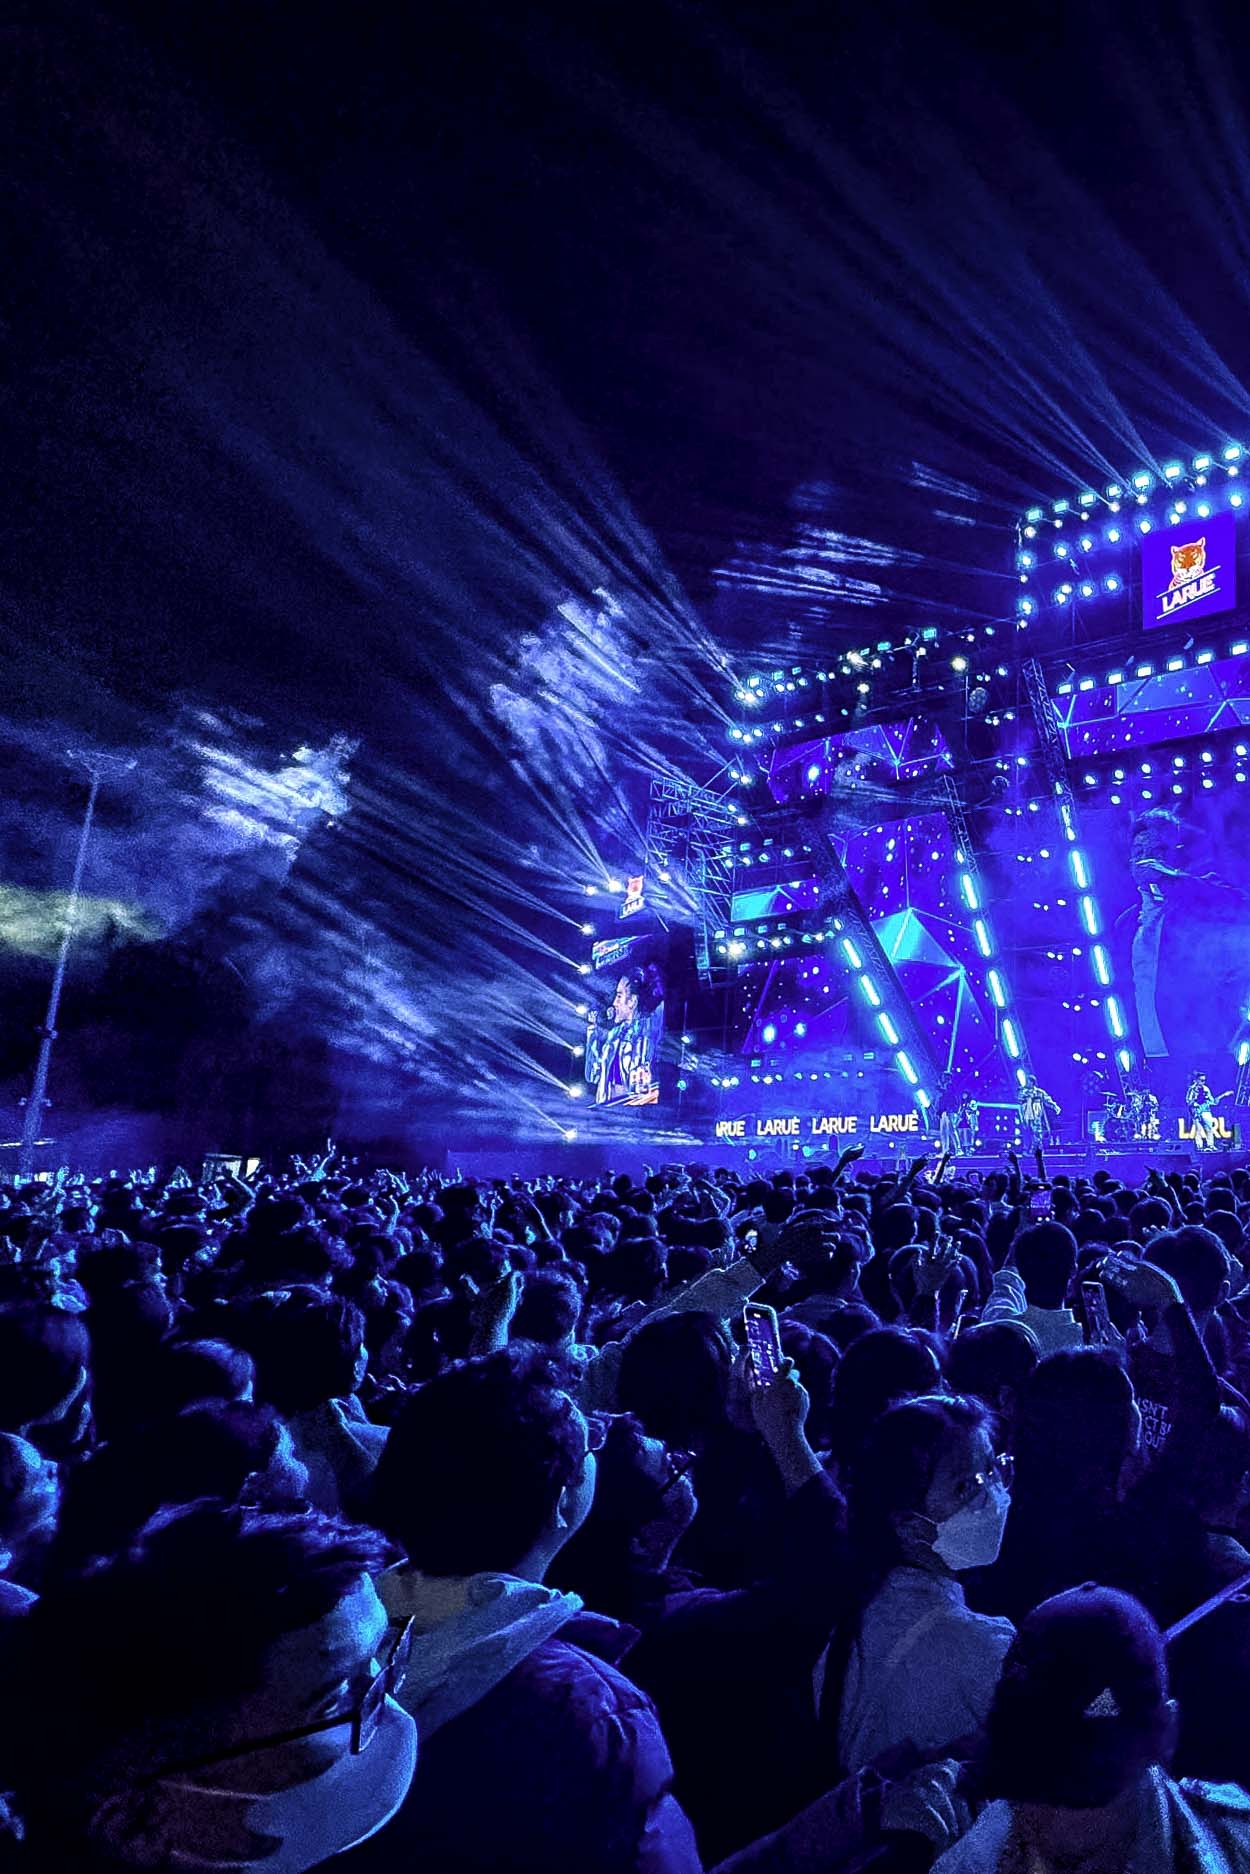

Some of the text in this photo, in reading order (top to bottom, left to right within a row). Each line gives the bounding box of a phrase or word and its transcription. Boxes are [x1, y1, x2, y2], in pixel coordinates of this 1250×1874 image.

[1162, 572, 1216, 612] LARUE
[757, 1118, 800, 1135] LARUE
[812, 1116, 857, 1134] LARUE
[870, 1113, 919, 1132] LARUE
